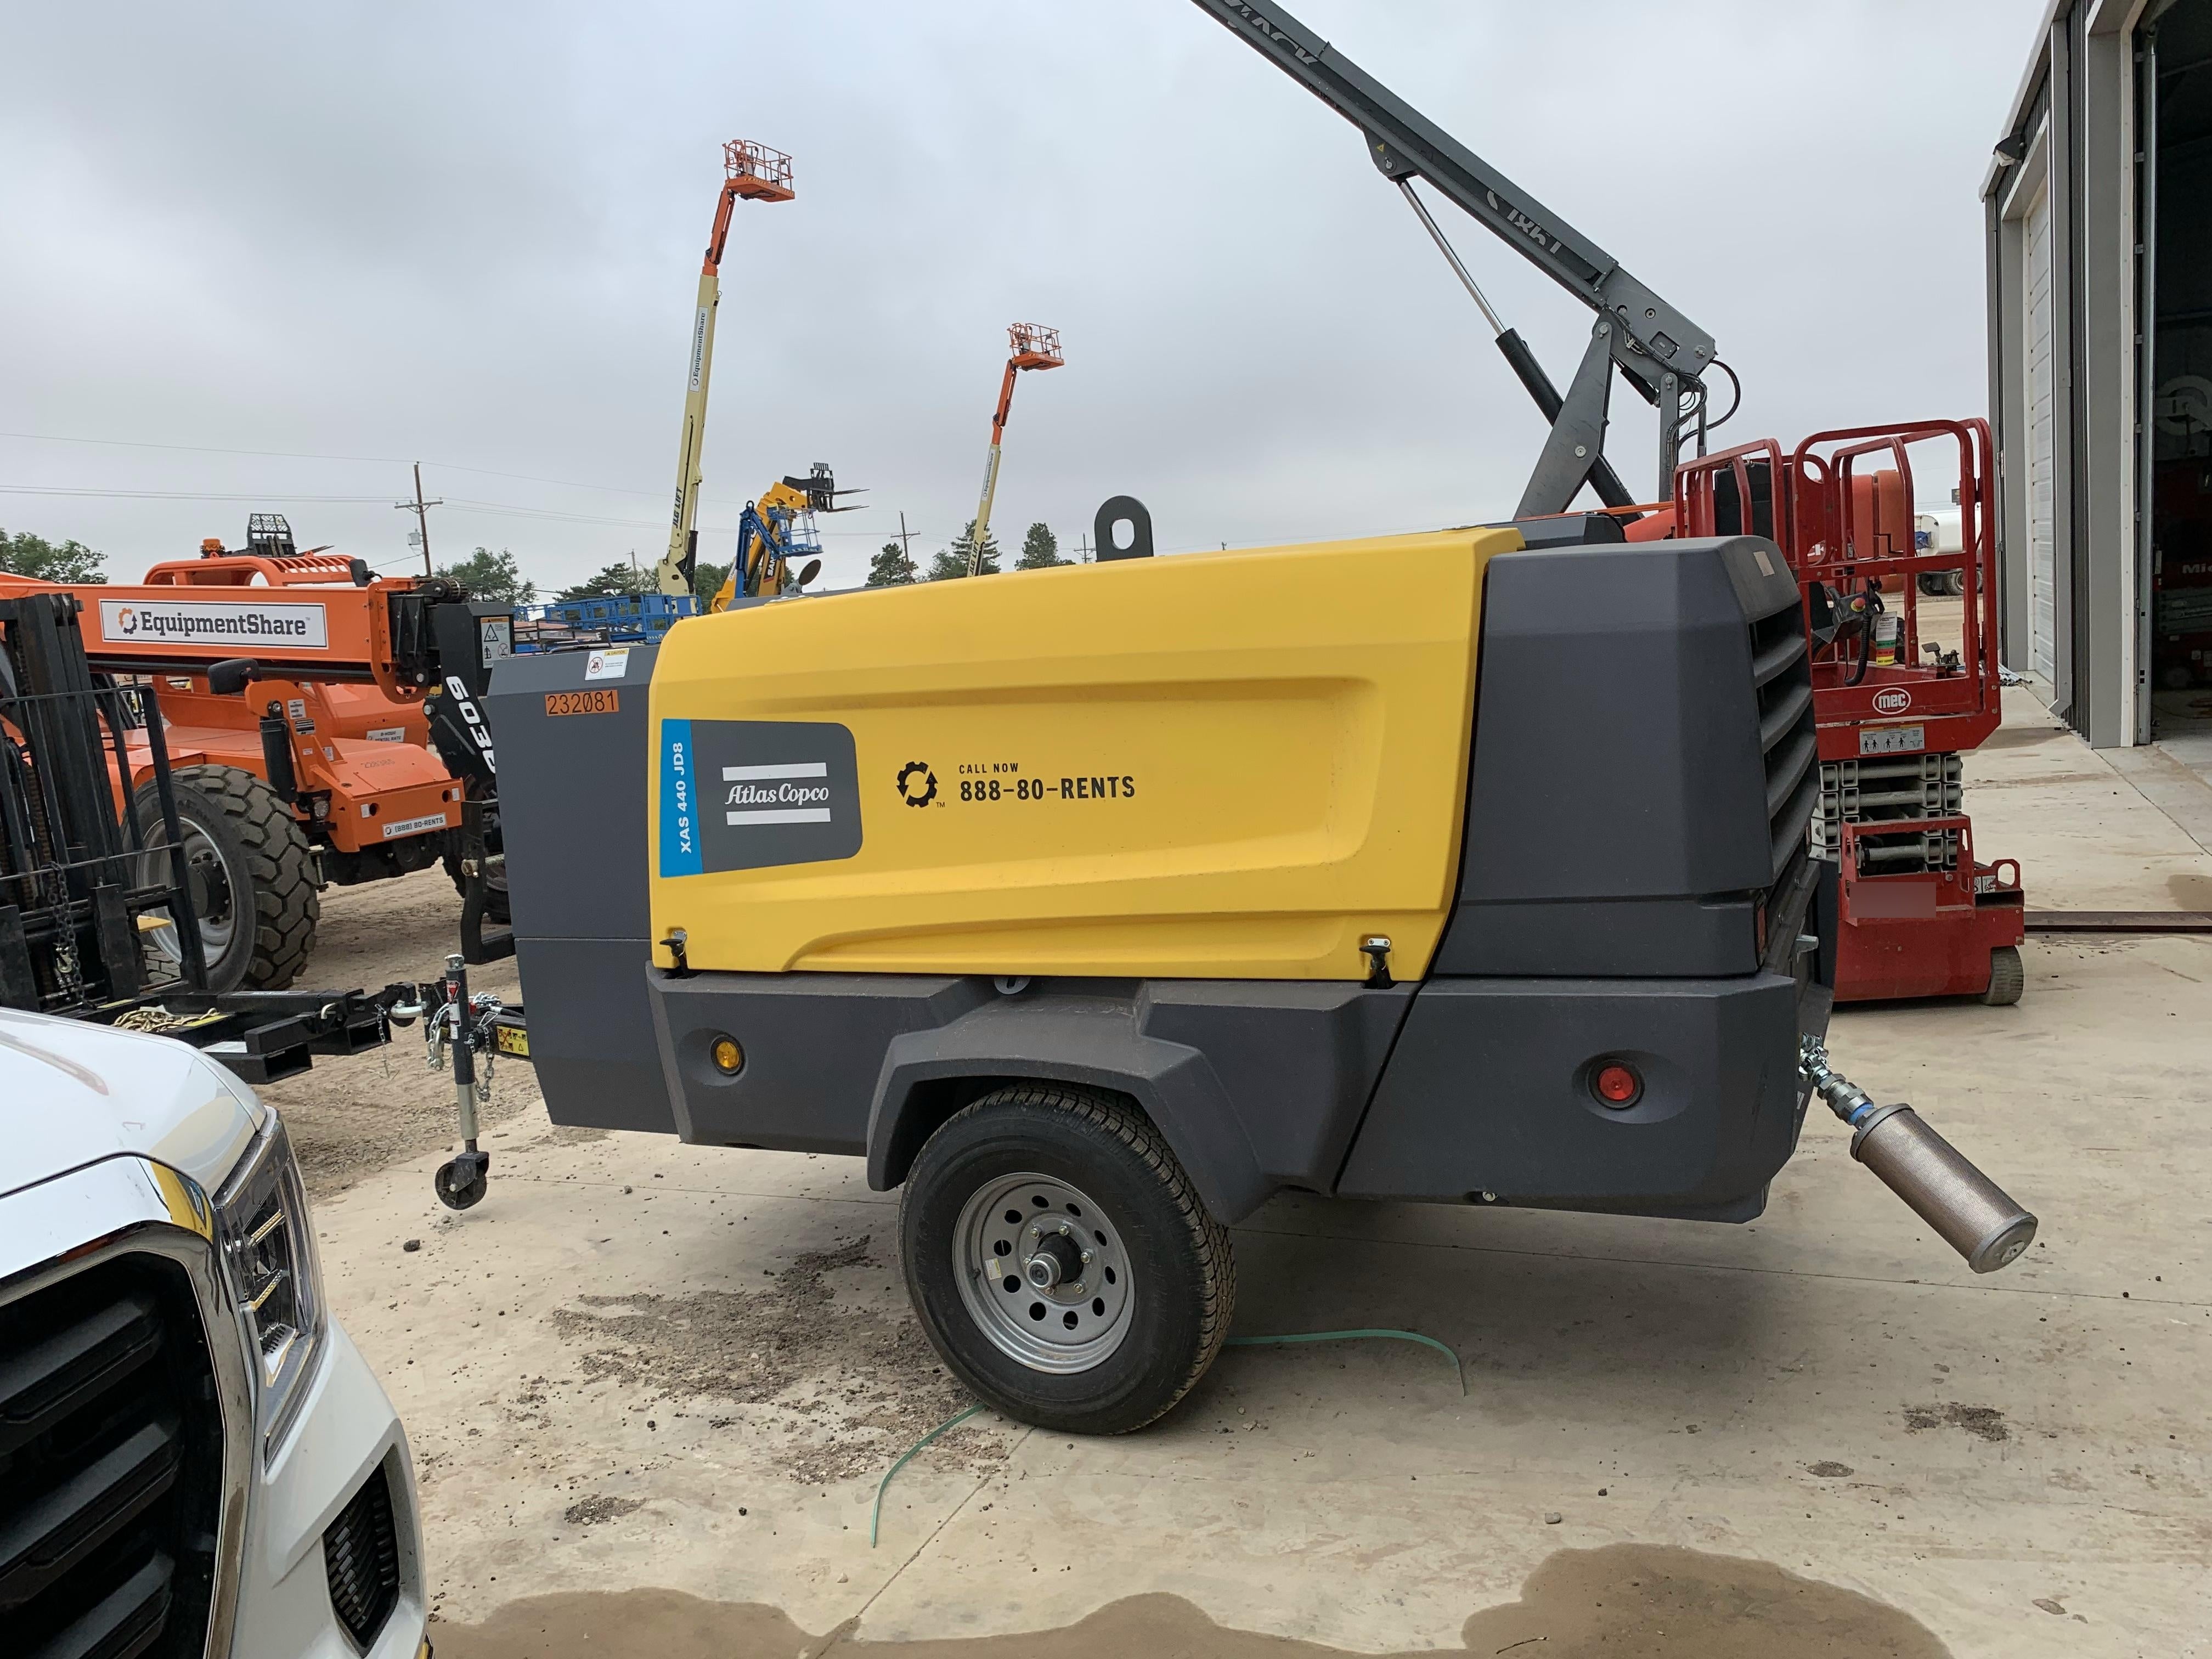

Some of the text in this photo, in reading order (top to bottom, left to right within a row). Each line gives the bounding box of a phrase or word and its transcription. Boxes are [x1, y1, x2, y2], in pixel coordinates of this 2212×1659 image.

[693, 313, 706, 377] EquipmentShare
[140, 611, 306, 636] EquipmentShare
[548, 691, 614, 714] 232081
[959, 763, 1018, 774] CALL NOW
[673, 742, 691, 854] XAS 440 JD8
[724, 783, 829, 805] Atlas Copco
[960, 776, 1135, 802] 888-80-RENTS
[394, 817, 443, 832] (888) 80-RENTS
